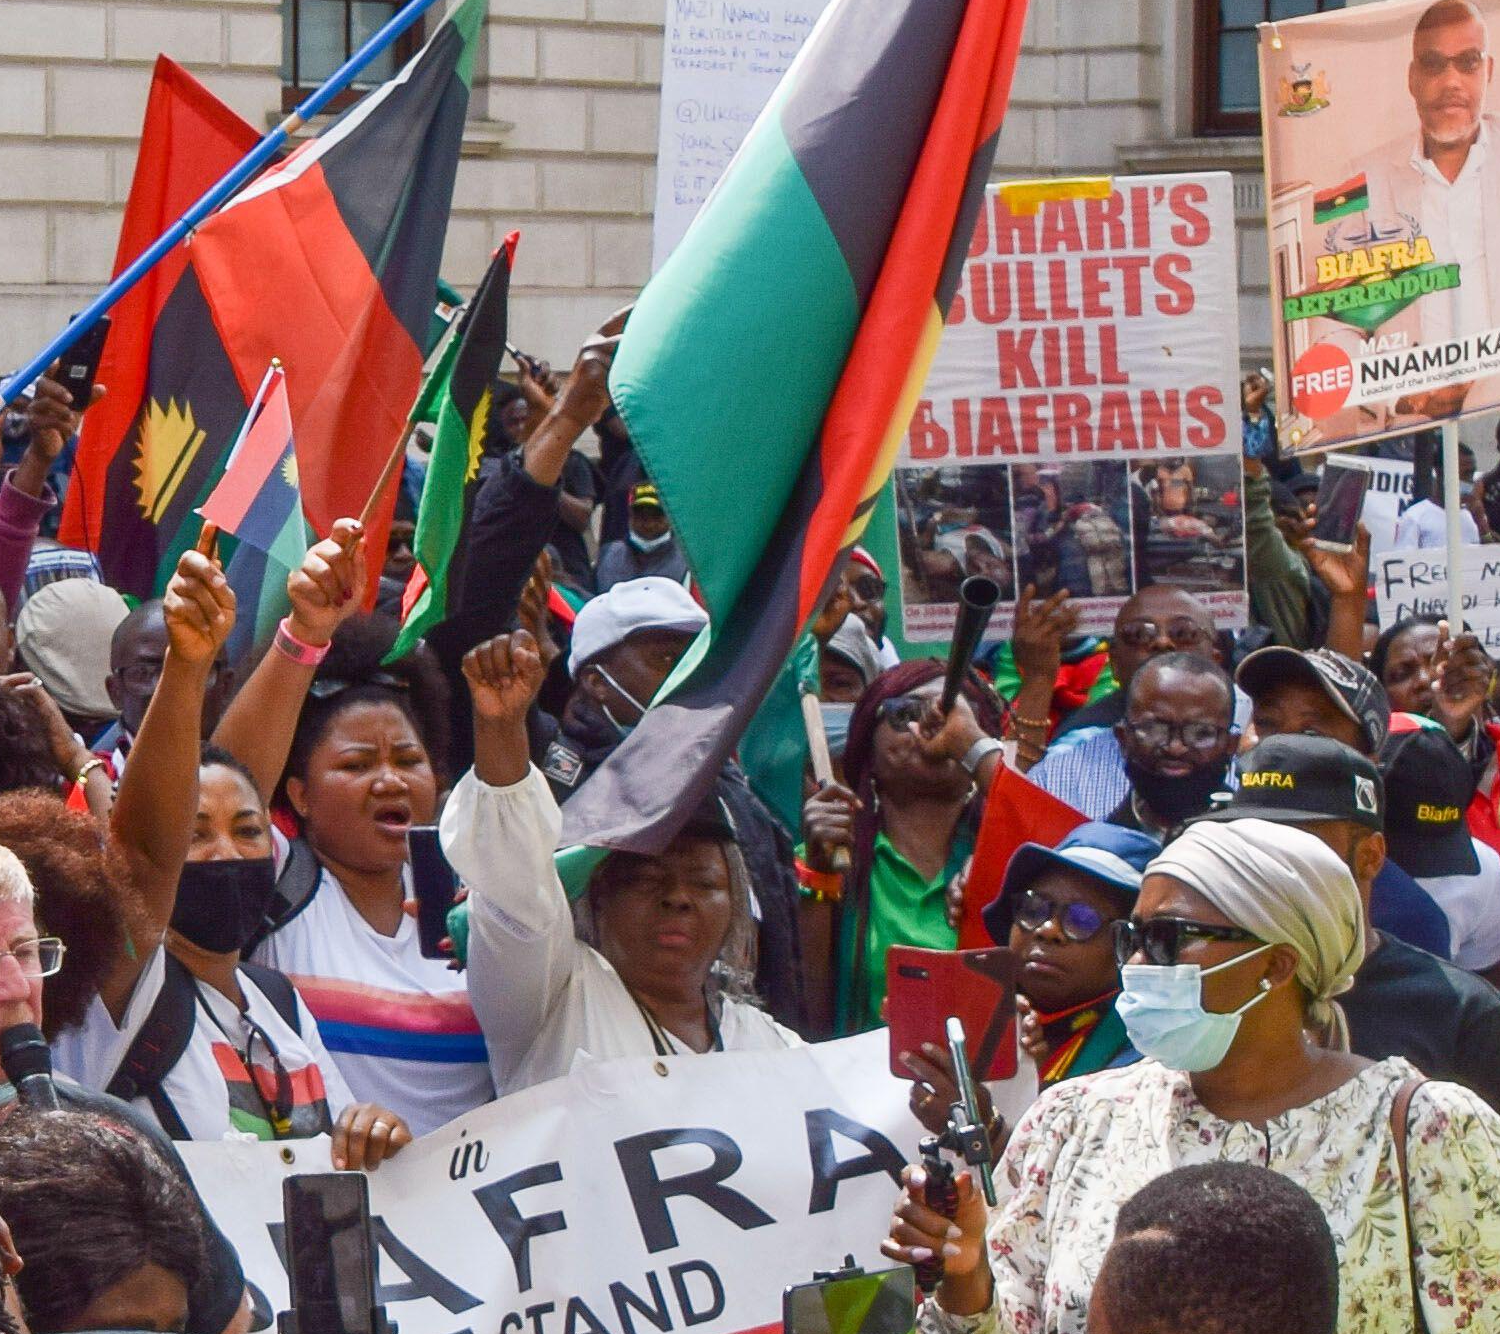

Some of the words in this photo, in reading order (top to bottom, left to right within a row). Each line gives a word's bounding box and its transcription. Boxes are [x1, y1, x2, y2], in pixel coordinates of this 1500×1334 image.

[1316, 236, 1436, 285] BIAFRA
[1282, 263, 1462, 323] REFERENDUM
[996, 323, 1130, 390] KILL
[1359, 332, 1408, 356] MAZI
[1360, 340, 1470, 385] NNAMDI
[1291, 365, 1351, 398] FREE
[1360, 381, 1394, 398] Leader
[1394, 378, 1408, 390] of
[1408, 375, 1425, 388] the
[1425, 366, 1478, 387] Indigenous
[1241, 771, 1294, 789] BIAFRA
[450, 1128, 491, 1183] in
